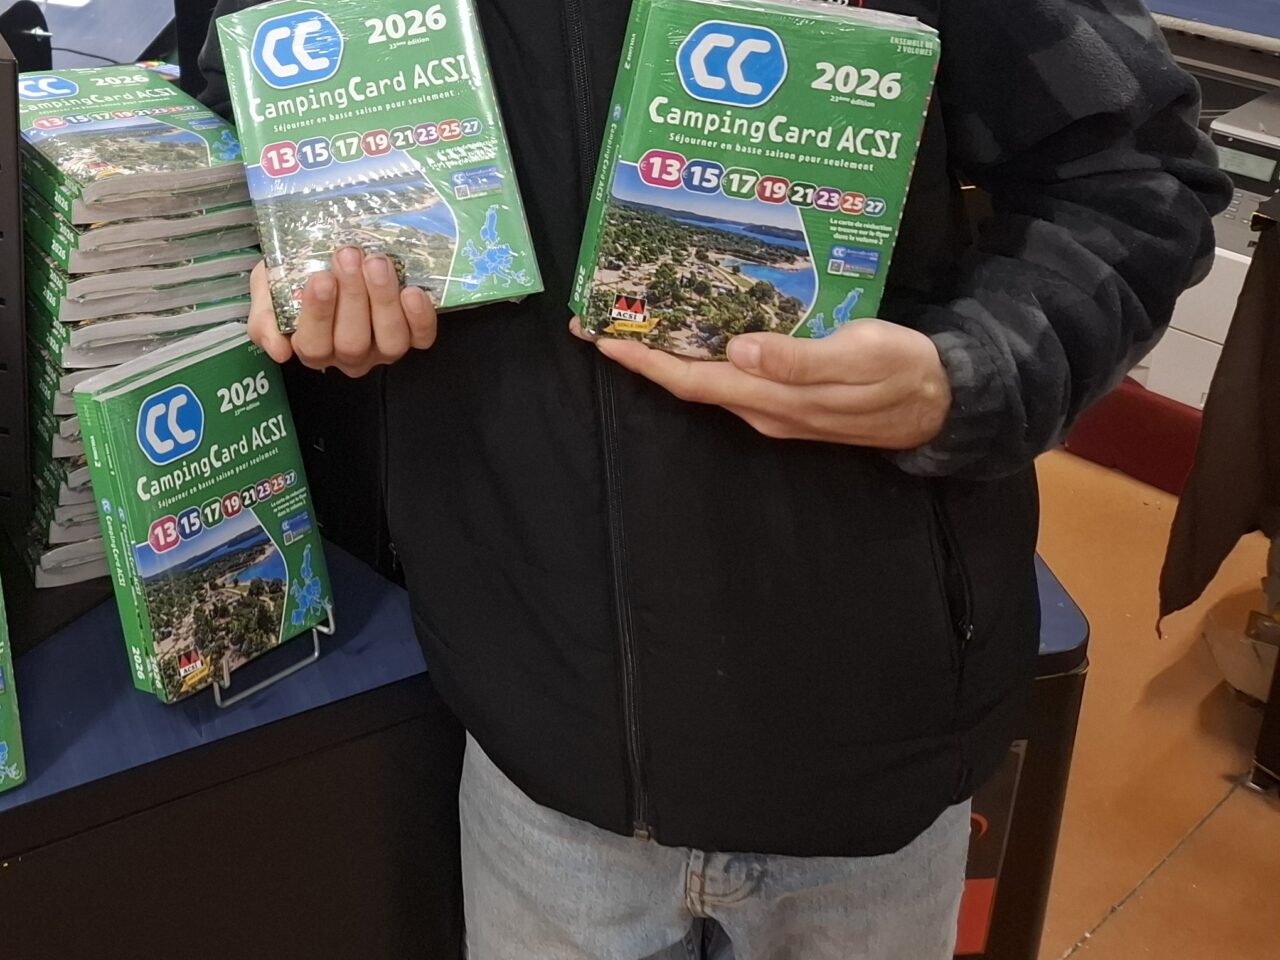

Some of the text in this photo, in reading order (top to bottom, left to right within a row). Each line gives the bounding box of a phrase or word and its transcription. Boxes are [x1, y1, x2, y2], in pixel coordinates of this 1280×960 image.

[262, 20, 330, 78] CC
[365, 4, 447, 44] 2026
[90, 74, 150, 86] 2026
[250, 54, 468, 122] CampingCard ACSI
[690, 33, 771, 96] CC
[811, 62, 902, 100] 2026
[40, 112, 112, 127] 13 15 17
[138, 88, 177, 99] ACSI
[267, 121, 479, 170] 13 15 17 19 21 23 25 27
[648, 96, 902, 159] CampingCard ACSI
[669, 132, 874, 172] Séjourner en basse saison pour seulement
[649, 156, 883, 213] 13 15 17 19 21 23 25 27
[217, 371, 269, 413] 2026
[145, 393, 196, 455] CC
[136, 414, 287, 501] CampingCard ACSI
[153, 473, 295, 546] 13 15 17 19 21 23 25 27
